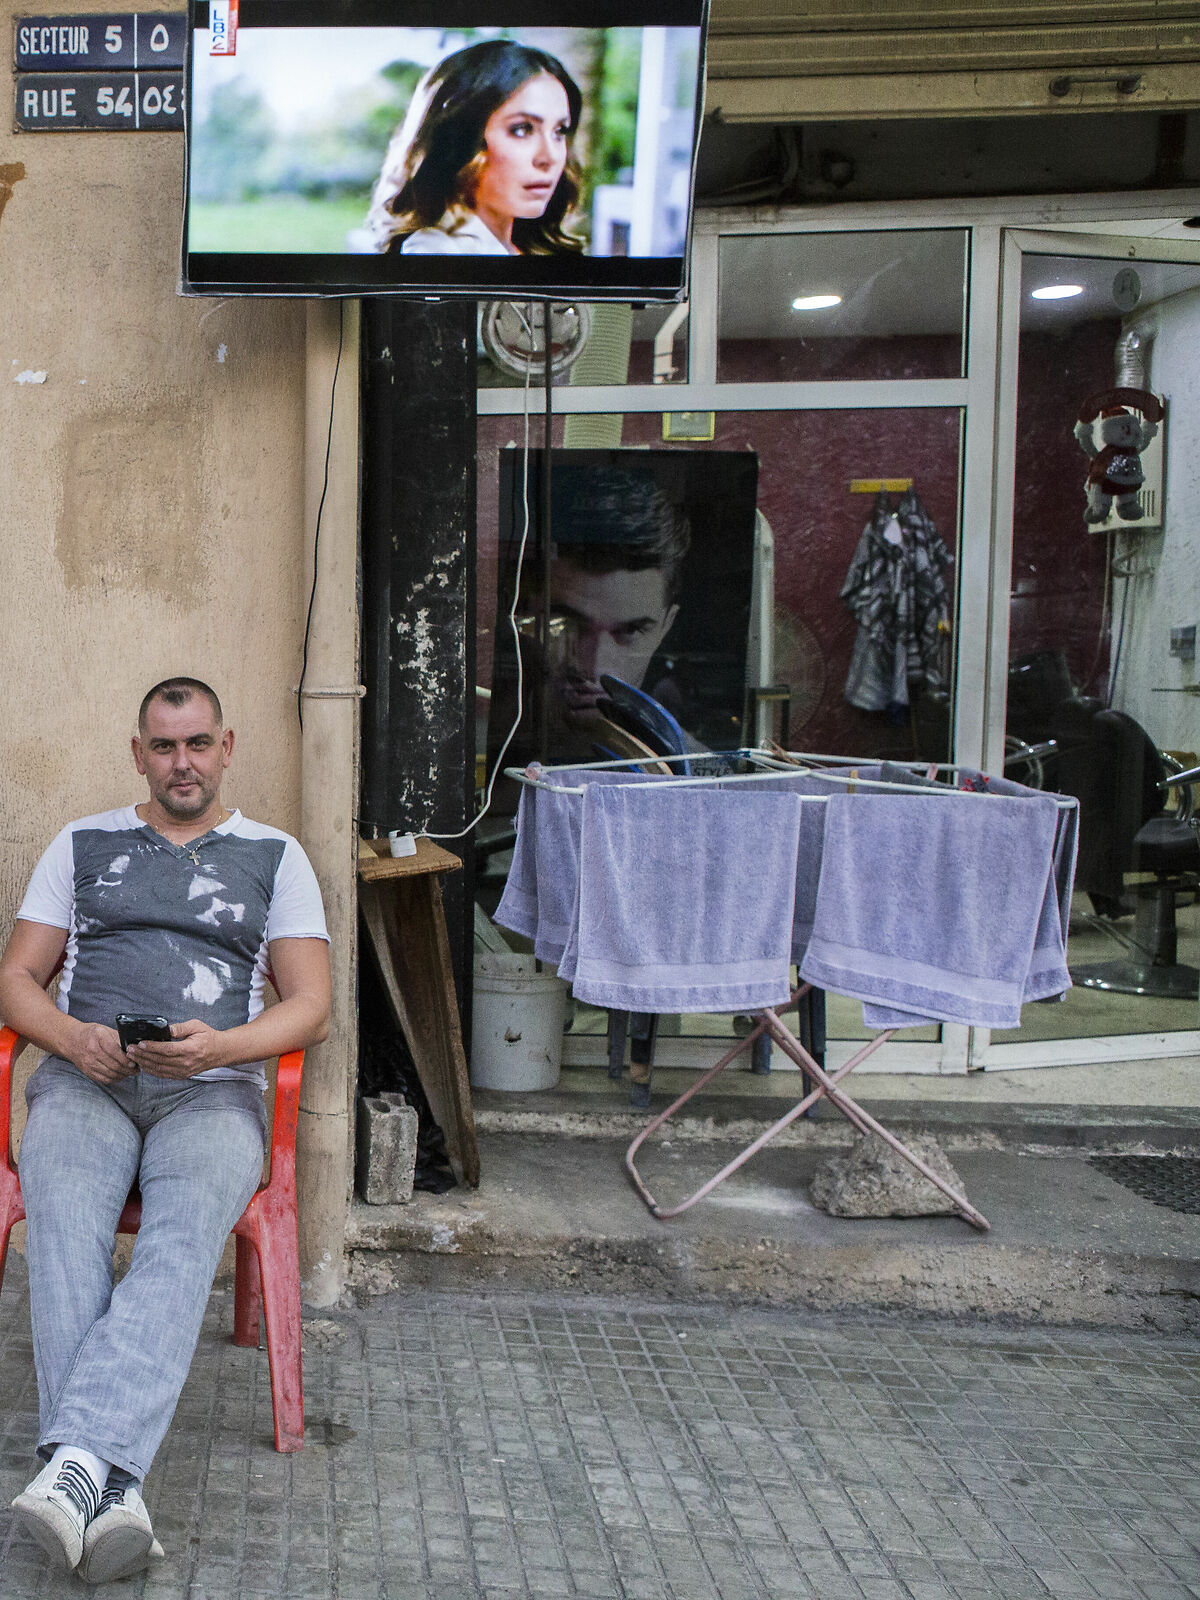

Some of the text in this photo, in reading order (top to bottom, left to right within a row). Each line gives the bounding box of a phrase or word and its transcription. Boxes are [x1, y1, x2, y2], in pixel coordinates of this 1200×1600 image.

[19, 24, 123, 55] SECTEUR 5
[23, 86, 134, 118] RUE 54
